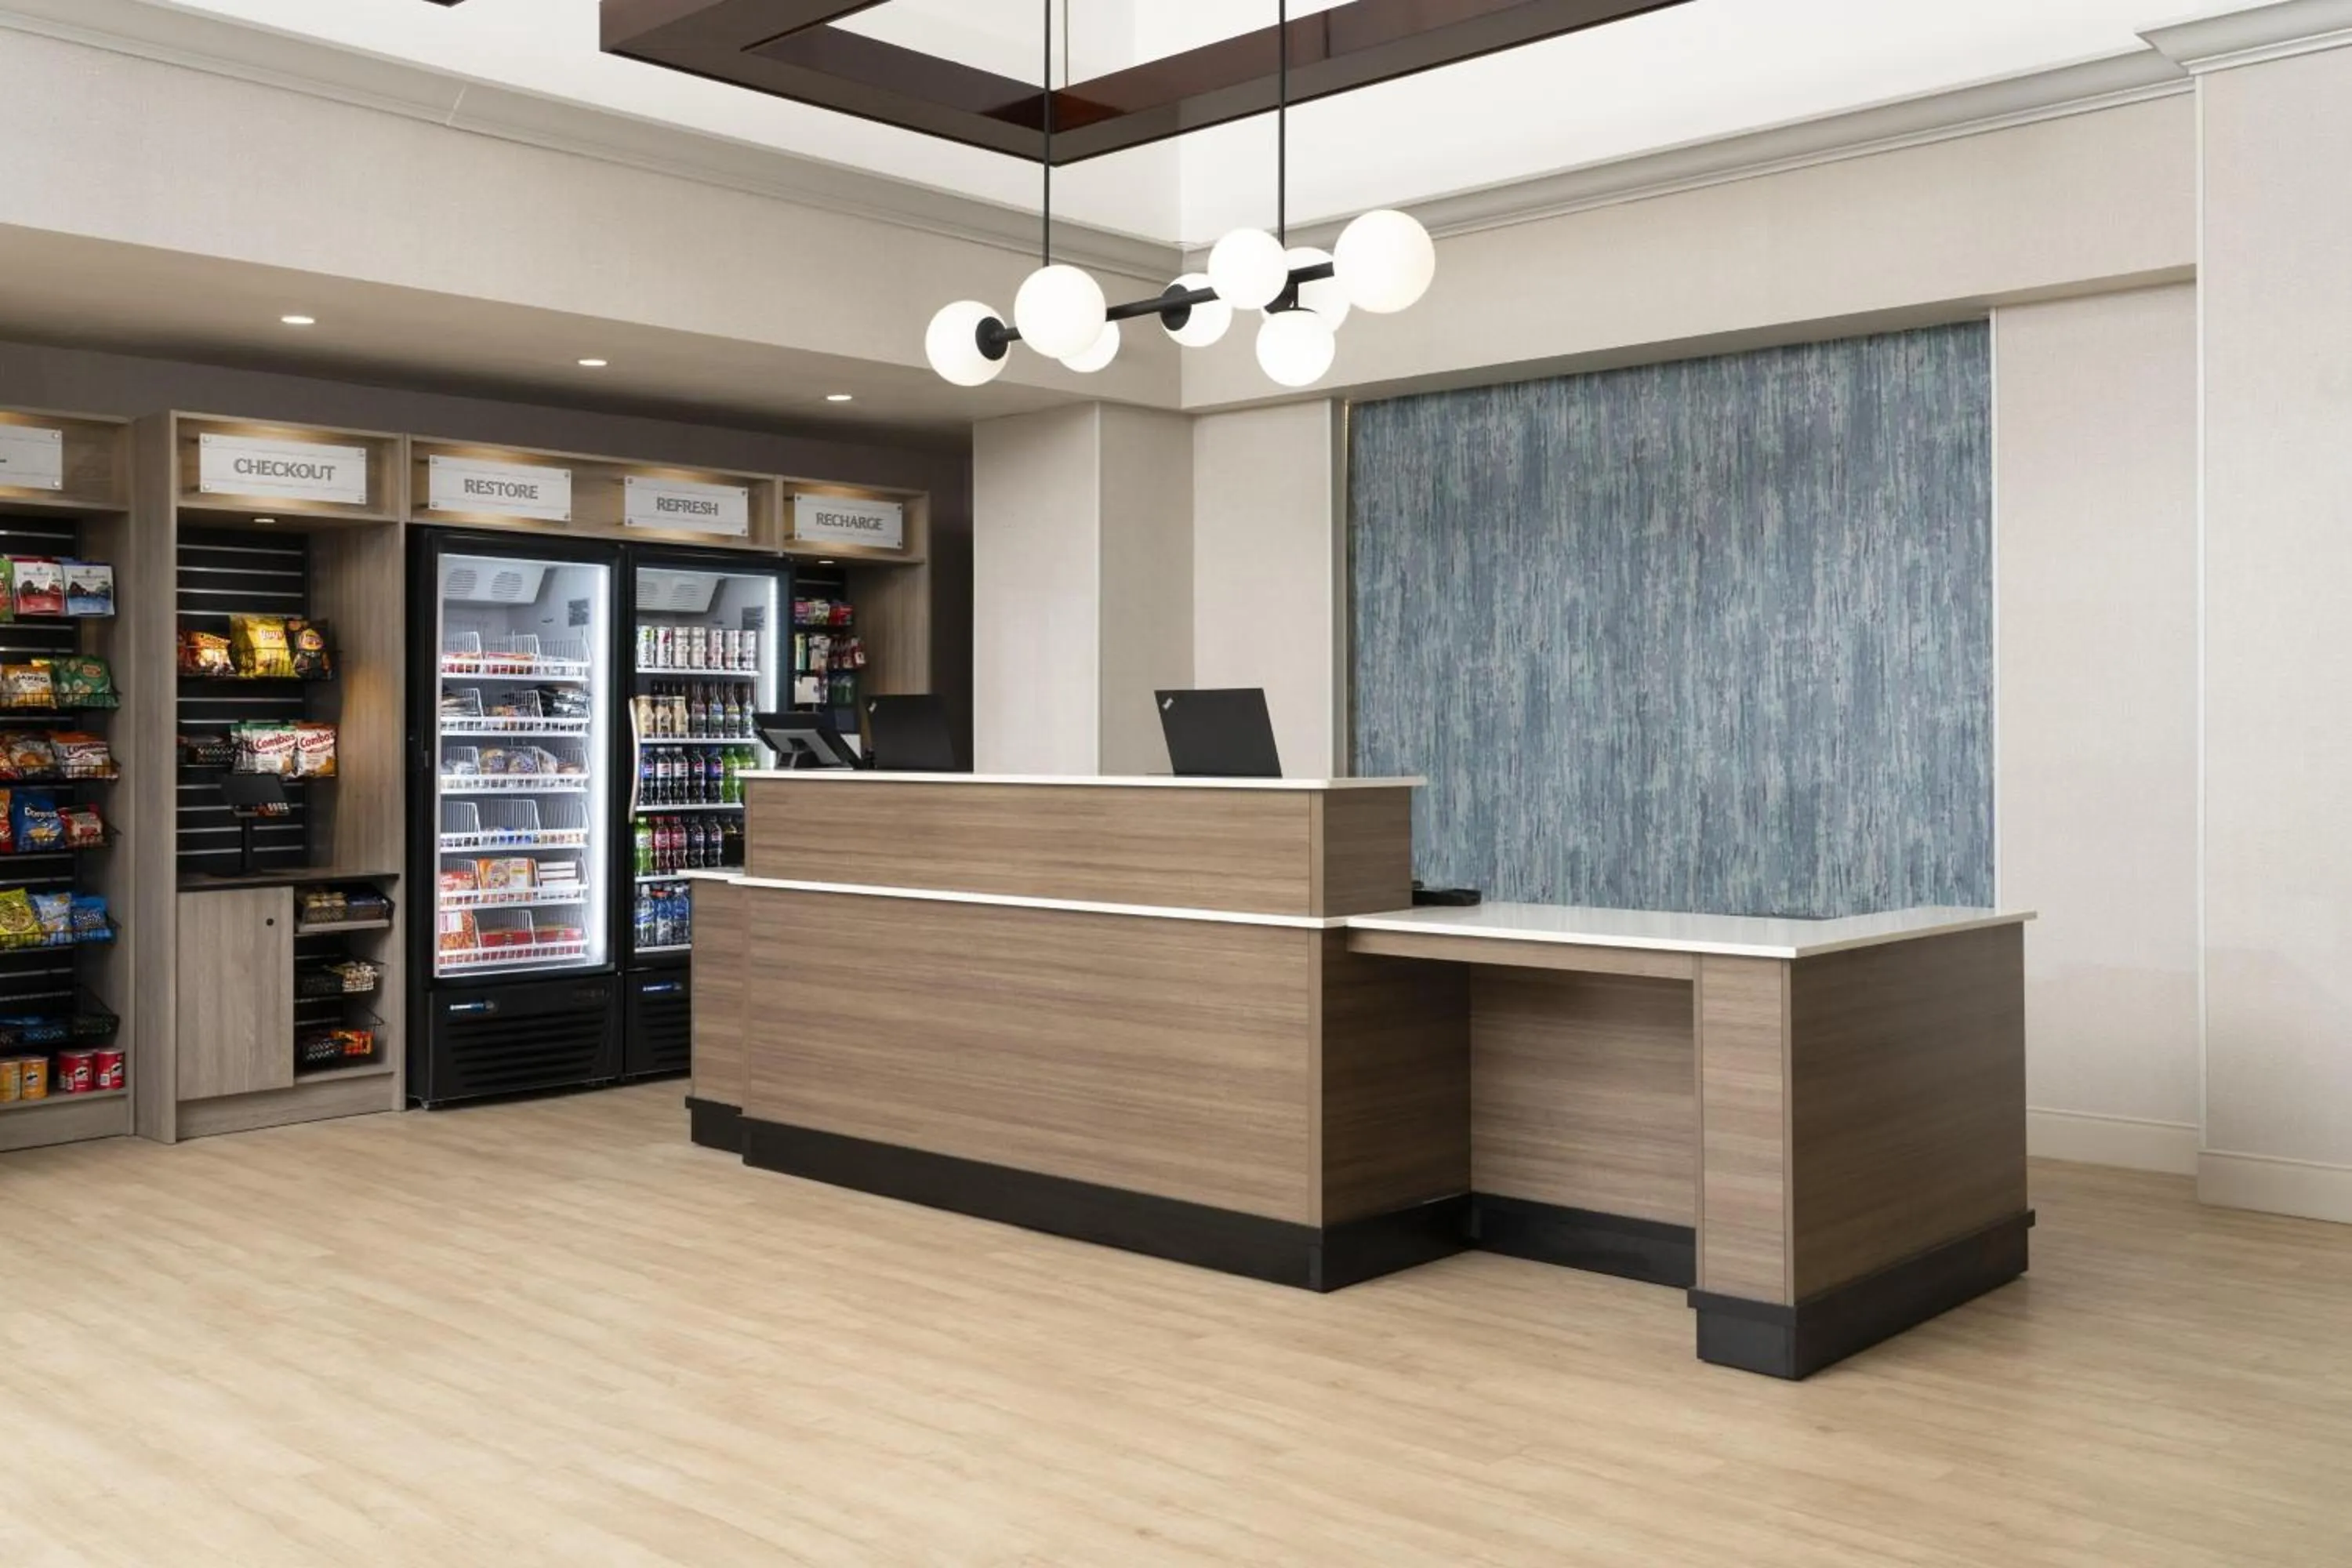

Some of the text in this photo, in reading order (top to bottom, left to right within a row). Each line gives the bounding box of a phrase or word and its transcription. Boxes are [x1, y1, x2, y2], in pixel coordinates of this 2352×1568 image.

[234, 459, 336, 481] CHECKOUT
[464, 478, 539, 499] RESTORE
[656, 497, 719, 516] REFRESH
[815, 512, 884, 531] RECHARGE
